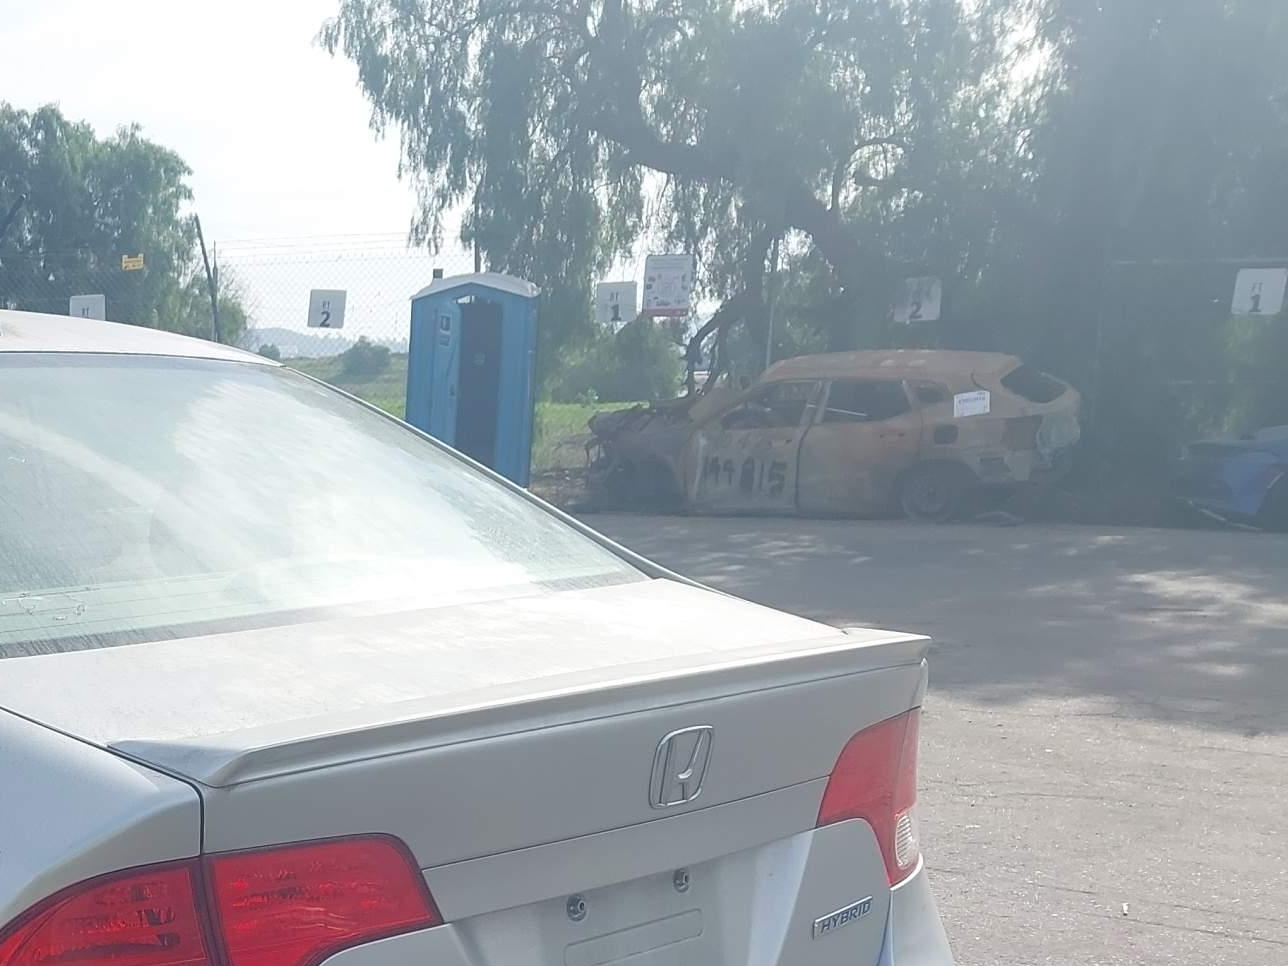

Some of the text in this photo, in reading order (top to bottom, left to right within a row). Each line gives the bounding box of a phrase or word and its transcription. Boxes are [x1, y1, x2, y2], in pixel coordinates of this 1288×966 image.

[319, 310, 330, 327] 2
[611, 304, 622, 321] 1
[819, 901, 872, 934] HYBRID
